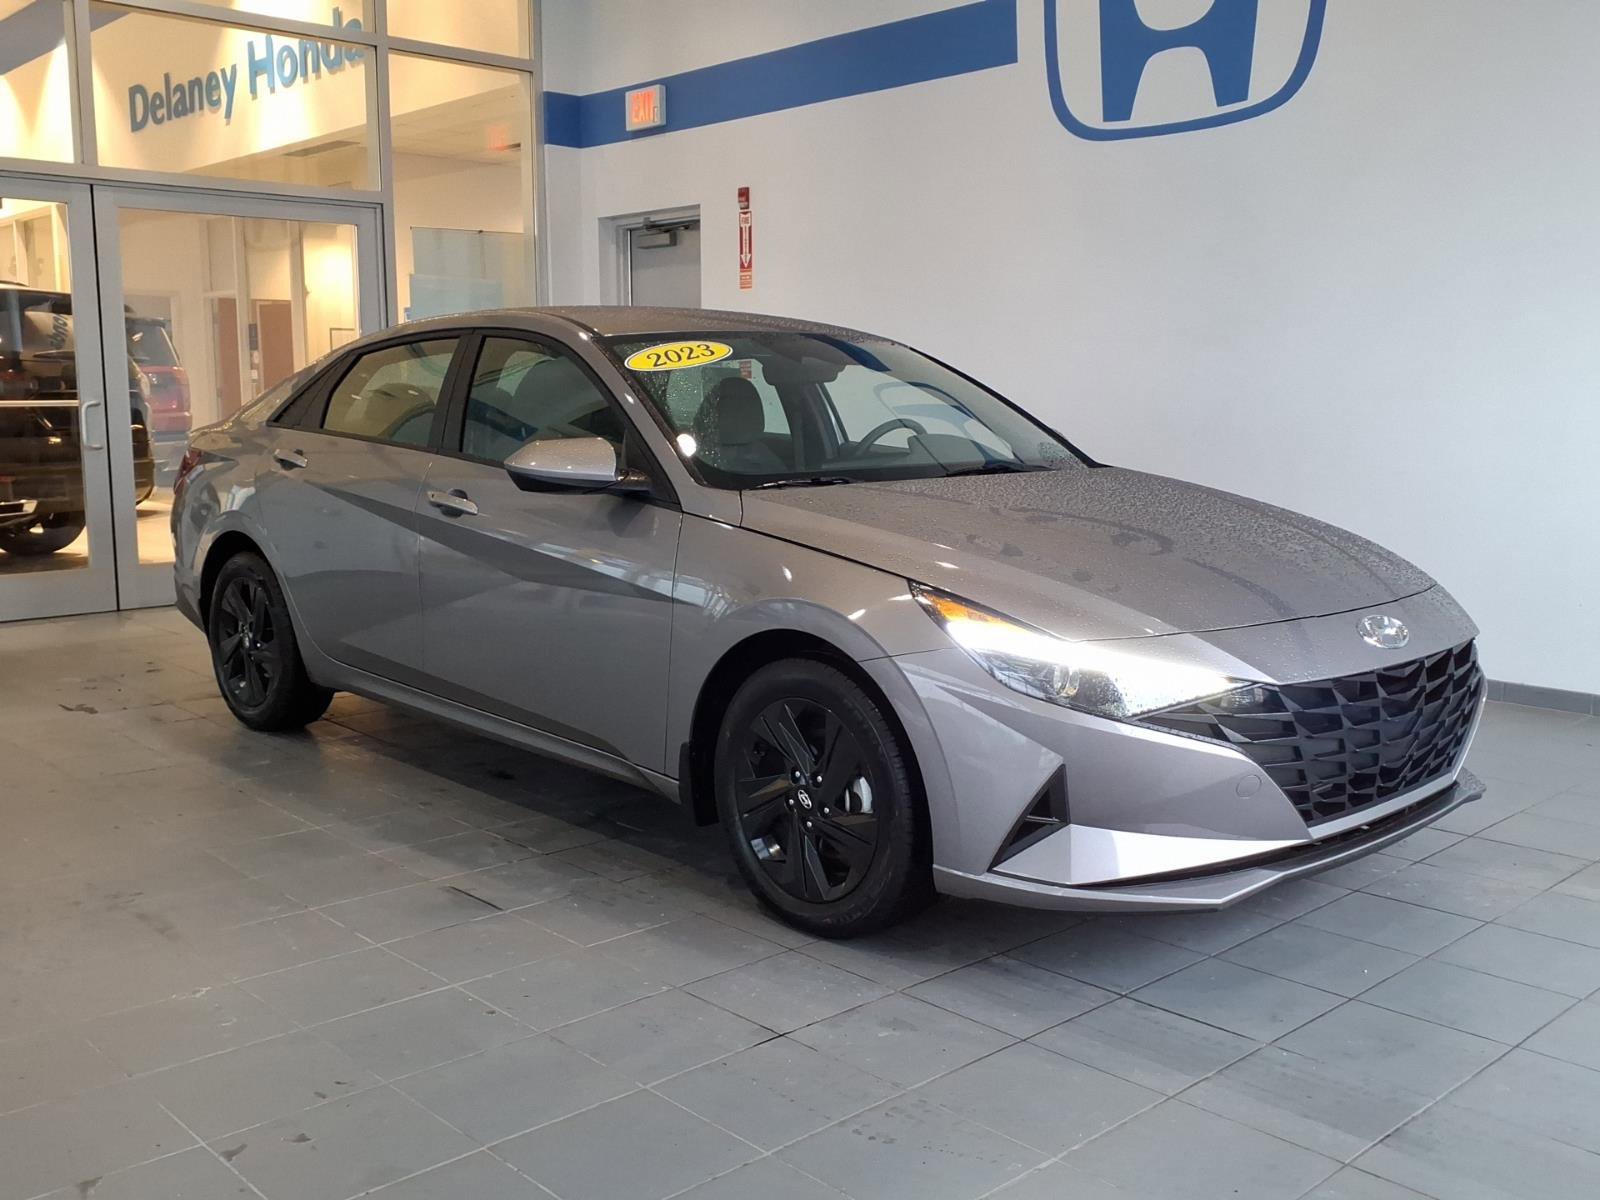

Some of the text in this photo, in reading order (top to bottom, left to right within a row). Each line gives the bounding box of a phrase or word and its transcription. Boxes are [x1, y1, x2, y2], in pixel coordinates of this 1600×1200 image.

[128, 7, 364, 133] Delaney Honda
[631, 89, 656, 122] EXIT
[646, 344, 716, 368] 2023
